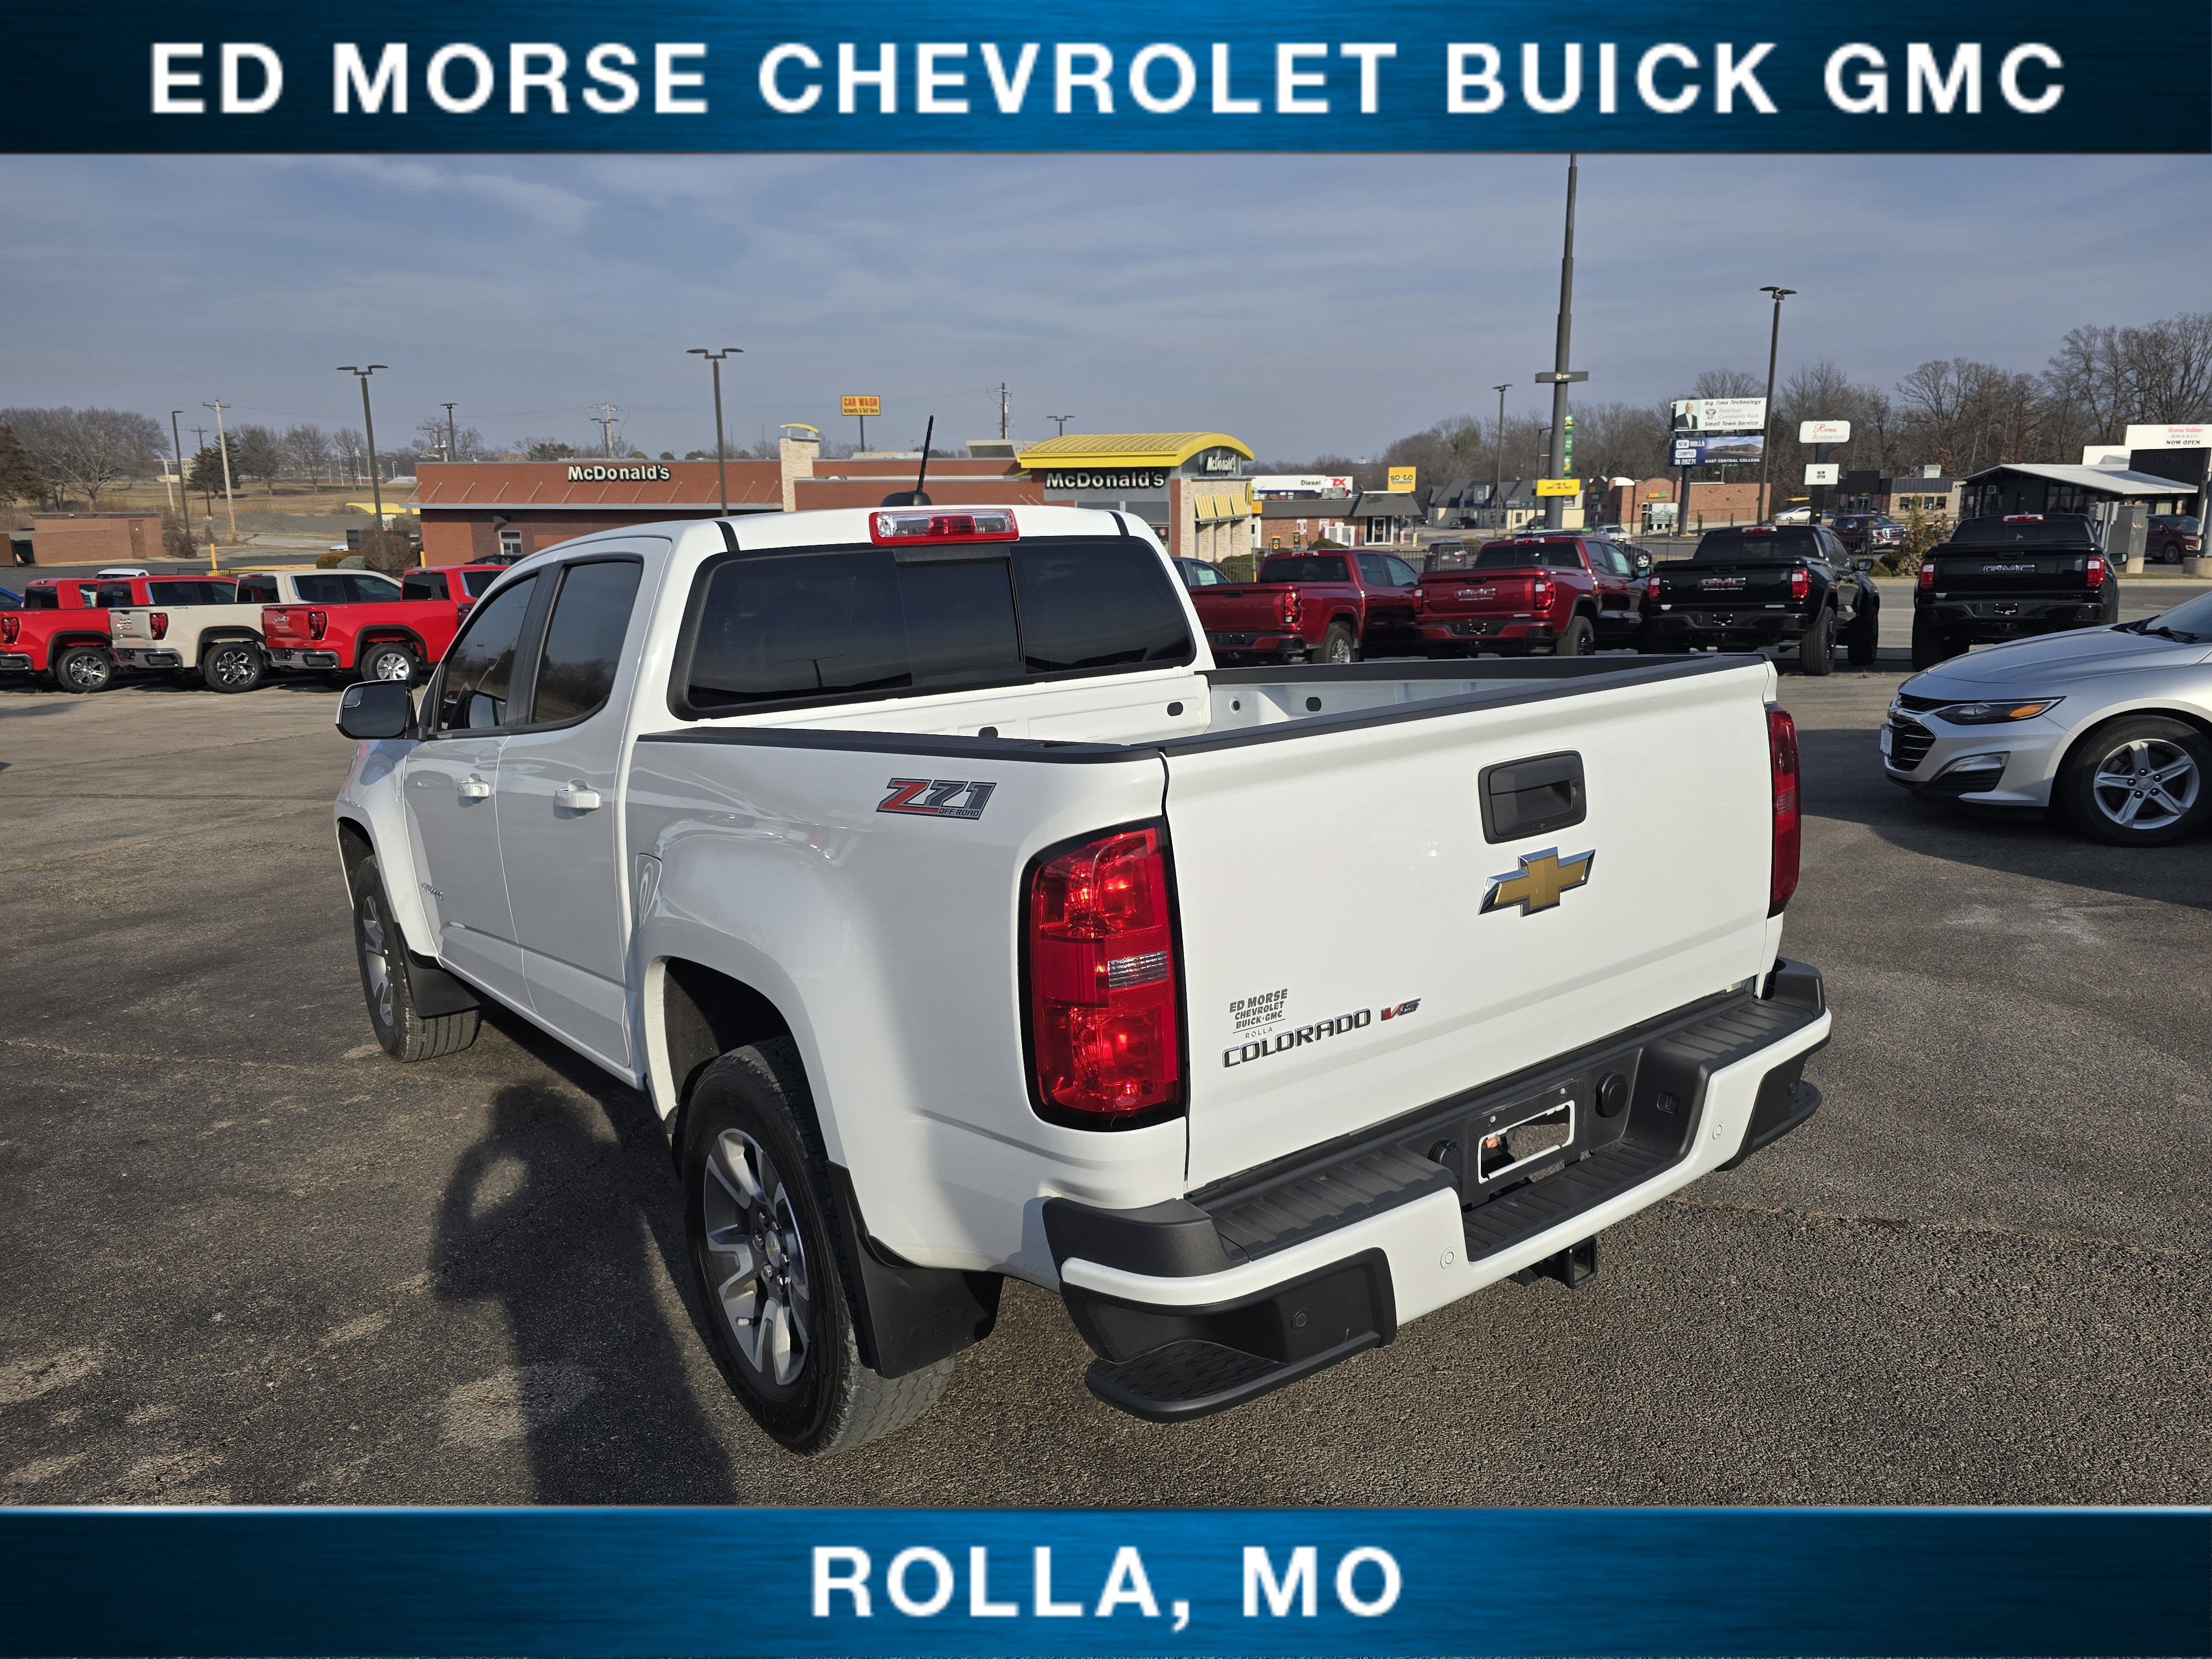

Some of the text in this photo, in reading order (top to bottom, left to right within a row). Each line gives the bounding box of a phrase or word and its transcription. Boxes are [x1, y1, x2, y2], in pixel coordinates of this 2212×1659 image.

[844, 398, 878, 406] CAR WASH
[568, 465, 671, 481] McDonald's
[1045, 471, 1165, 488] McDonald's
[1983, 564, 2035, 573] GMC
[877, 778, 997, 820] Z71
[1229, 988, 1288, 1013] ED MORSE
[1234, 1000, 1284, 1020] CHEVROLET
[1222, 997, 1422, 1068] COLORADO V6
[1245, 1026, 1273, 1039] ROLLA
